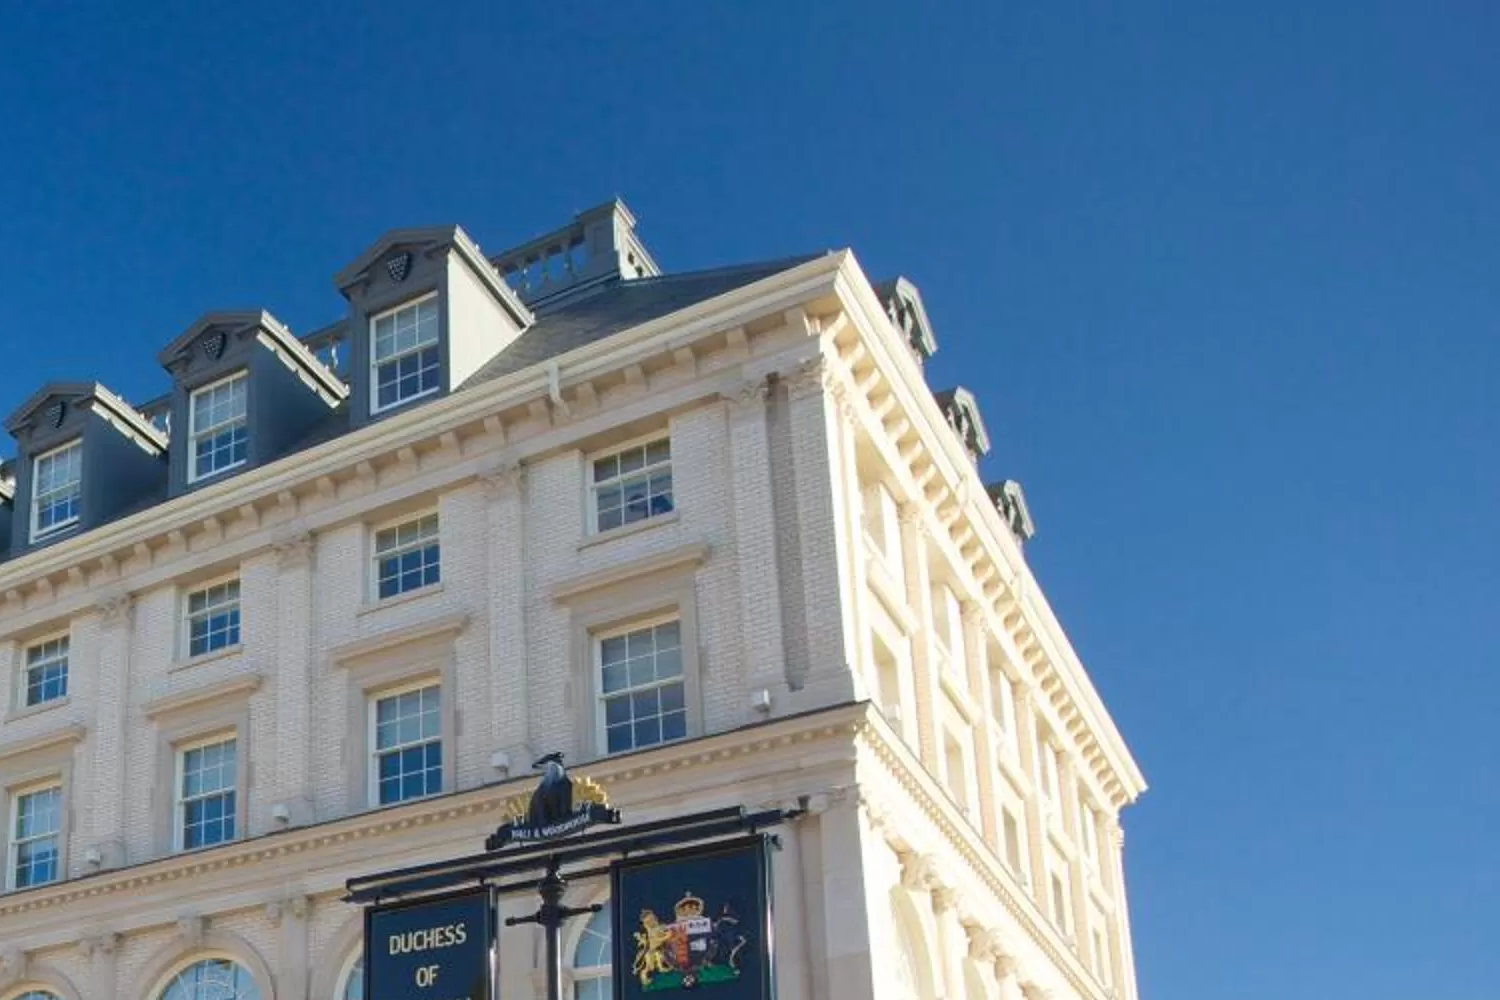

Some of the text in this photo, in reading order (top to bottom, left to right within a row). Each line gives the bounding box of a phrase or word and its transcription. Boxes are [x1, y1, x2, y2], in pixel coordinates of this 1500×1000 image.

[511, 812, 590, 839] HALL & WOODHOUSE
[389, 923, 467, 955] DUCHESS
[415, 964, 440, 987] OF
